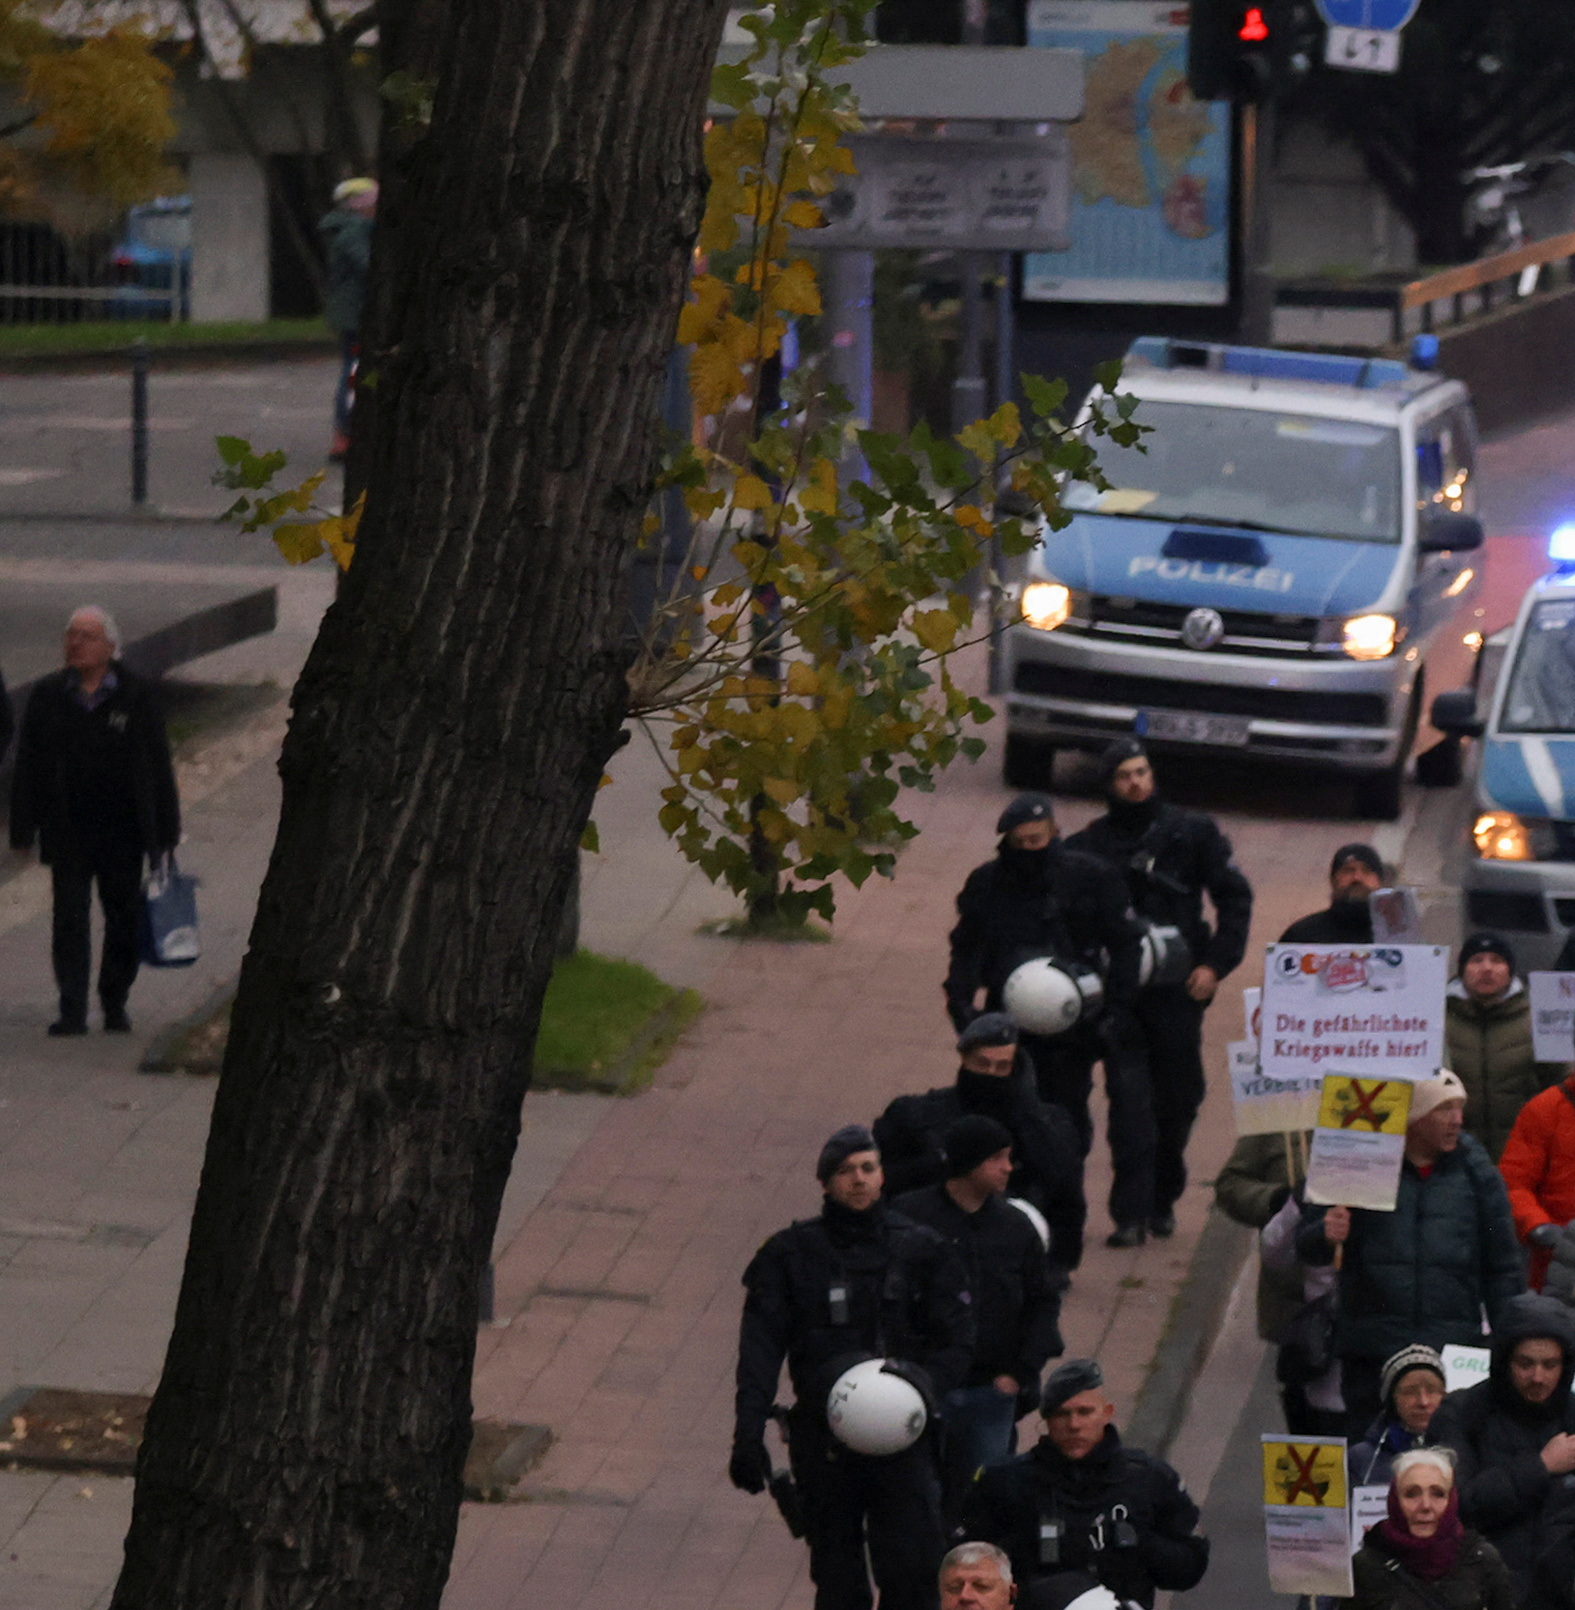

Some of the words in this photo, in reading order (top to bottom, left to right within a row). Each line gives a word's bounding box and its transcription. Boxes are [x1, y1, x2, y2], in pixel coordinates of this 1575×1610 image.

[1128, 556, 1295, 594] POLIZEI
[1276, 1014, 1306, 1032] Die
[1313, 1014, 1428, 1038] gefährlichste
[1274, 1039, 1380, 1063] Kriegswaffe
[1385, 1039, 1428, 1057] hier!
